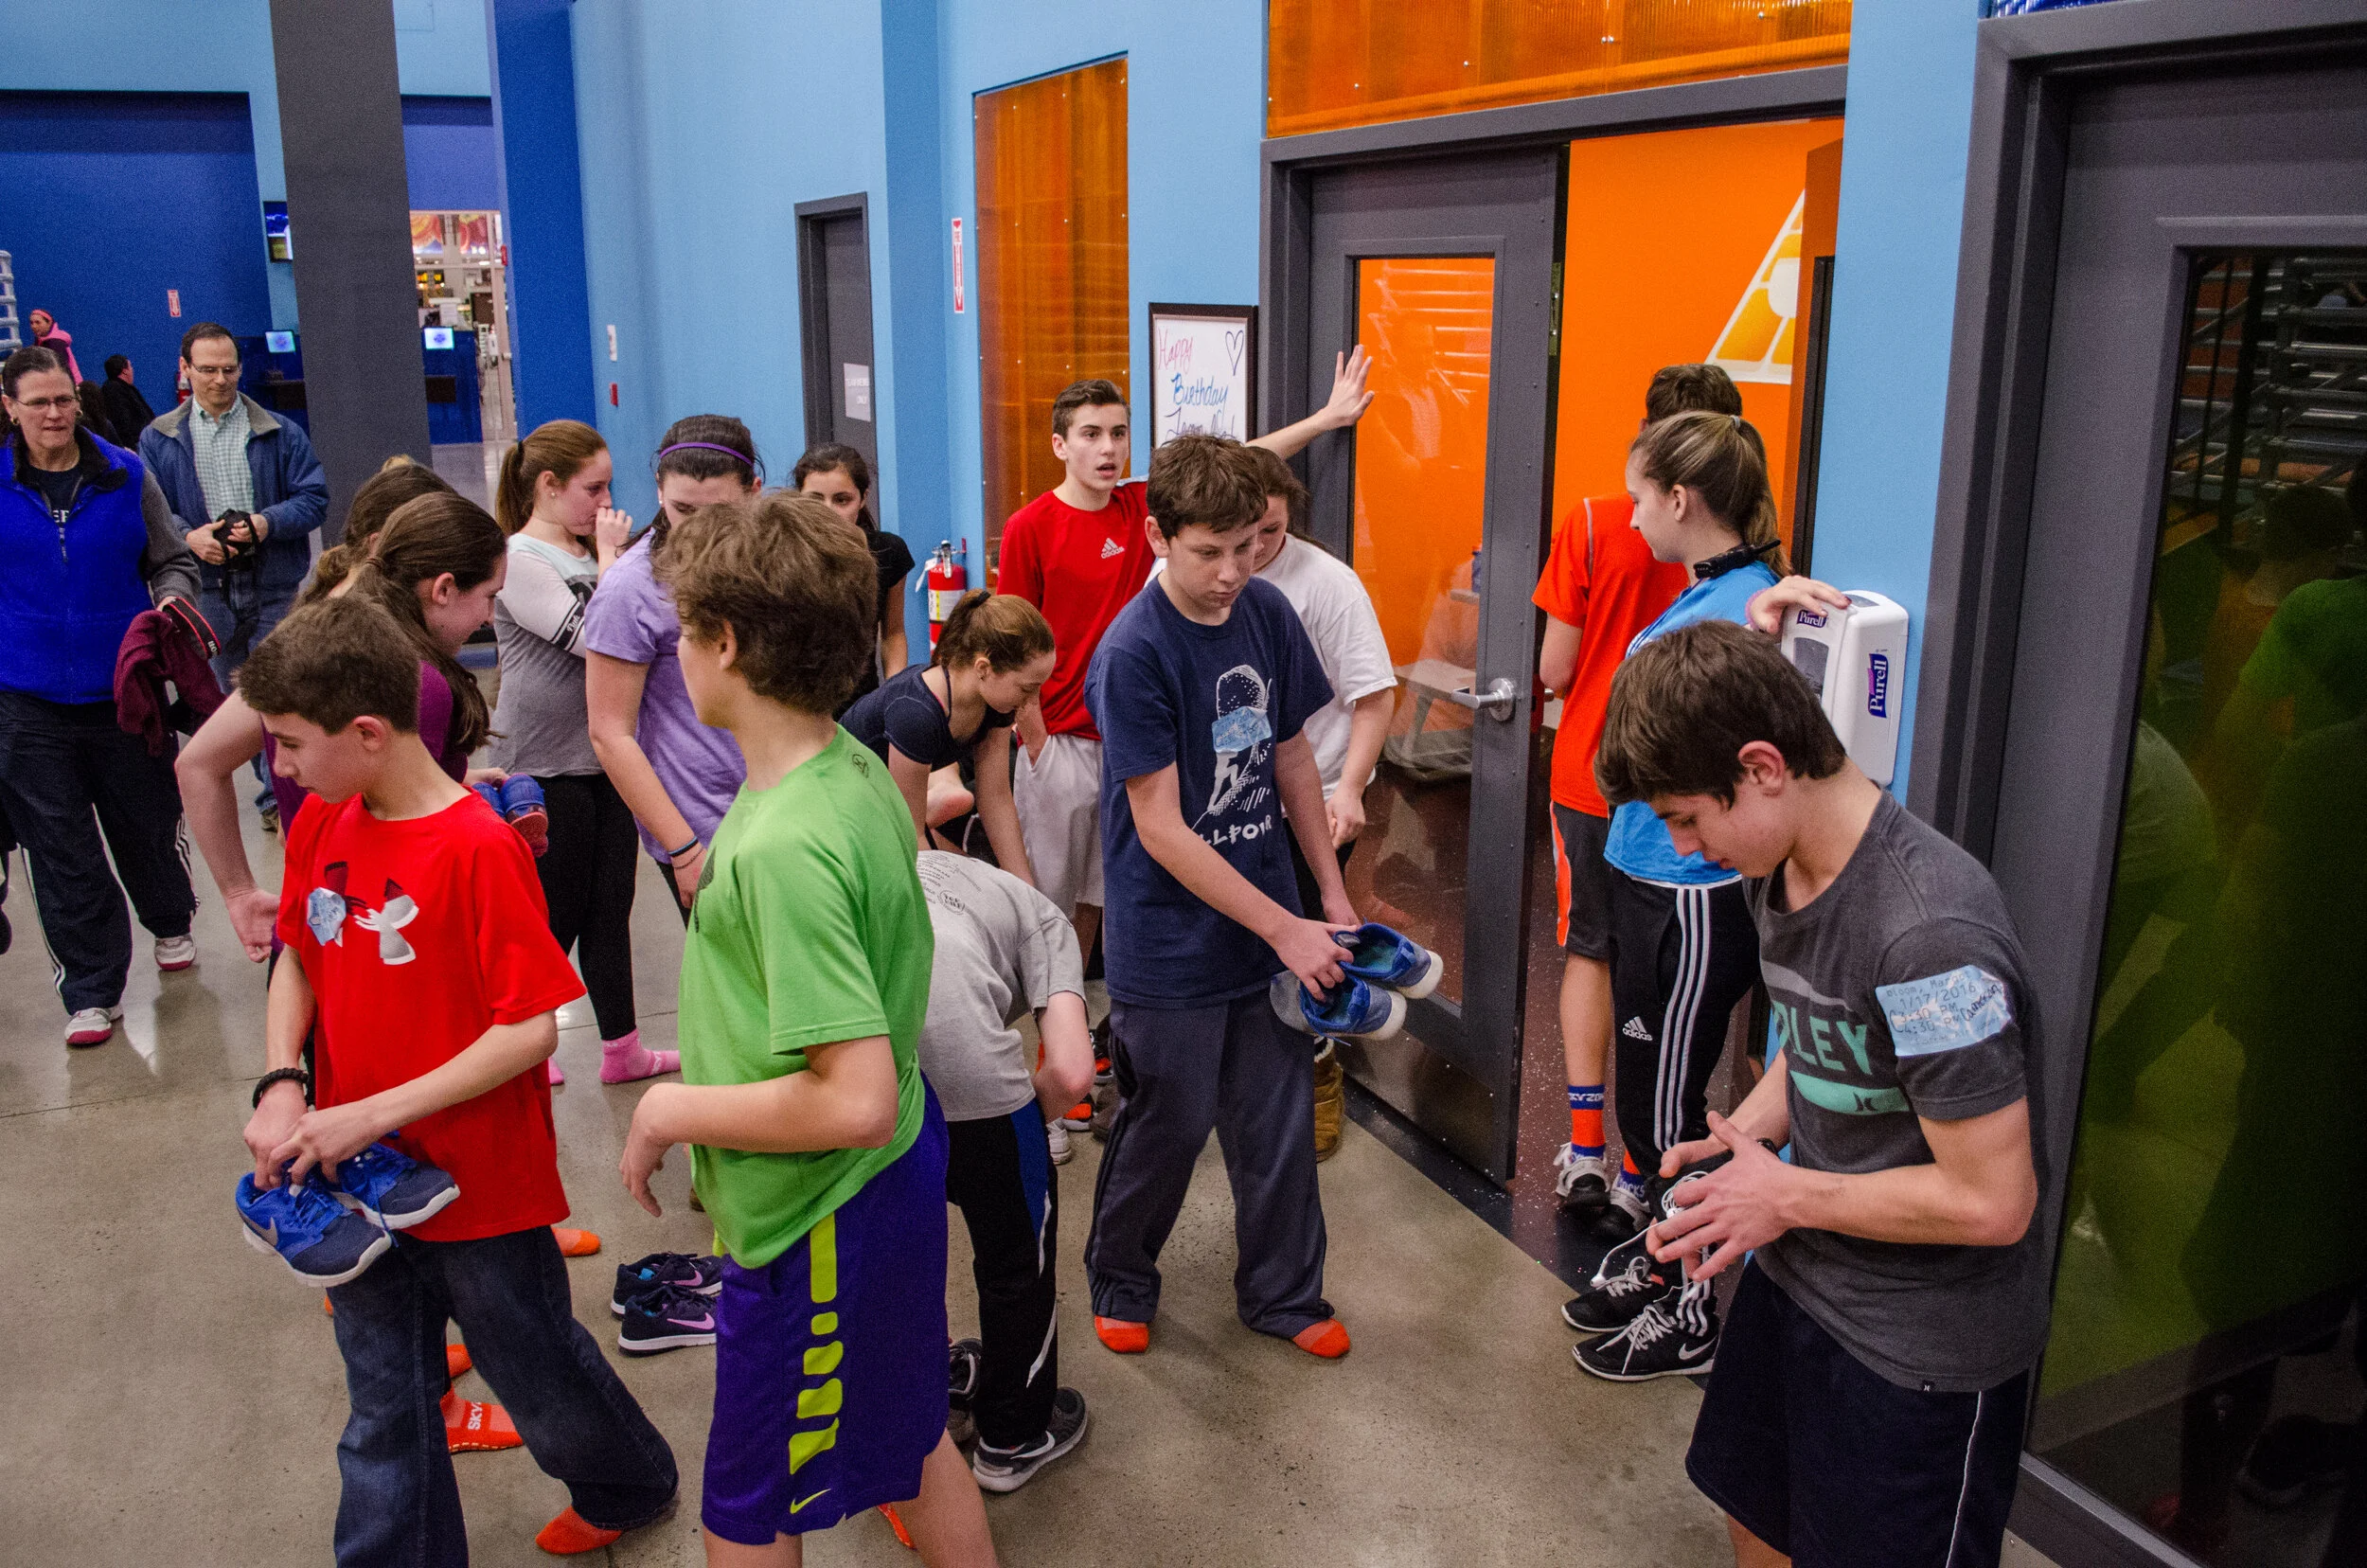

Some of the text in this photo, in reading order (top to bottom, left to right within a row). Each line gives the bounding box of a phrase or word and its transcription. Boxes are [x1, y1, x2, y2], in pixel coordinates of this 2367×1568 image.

[1157, 327, 1193, 375] Happy
[1170, 371, 1229, 422] Birthday
[1799, 611, 1824, 627] Purell
[1869, 660, 1887, 712] Purell
[1899, 981, 1977, 1009] 1/17/2016
[1898, 1002, 1958, 1023] 3:30 PM
[1622, 1027, 1653, 1042] adidas
[1904, 1020, 1935, 1034] 4:30
